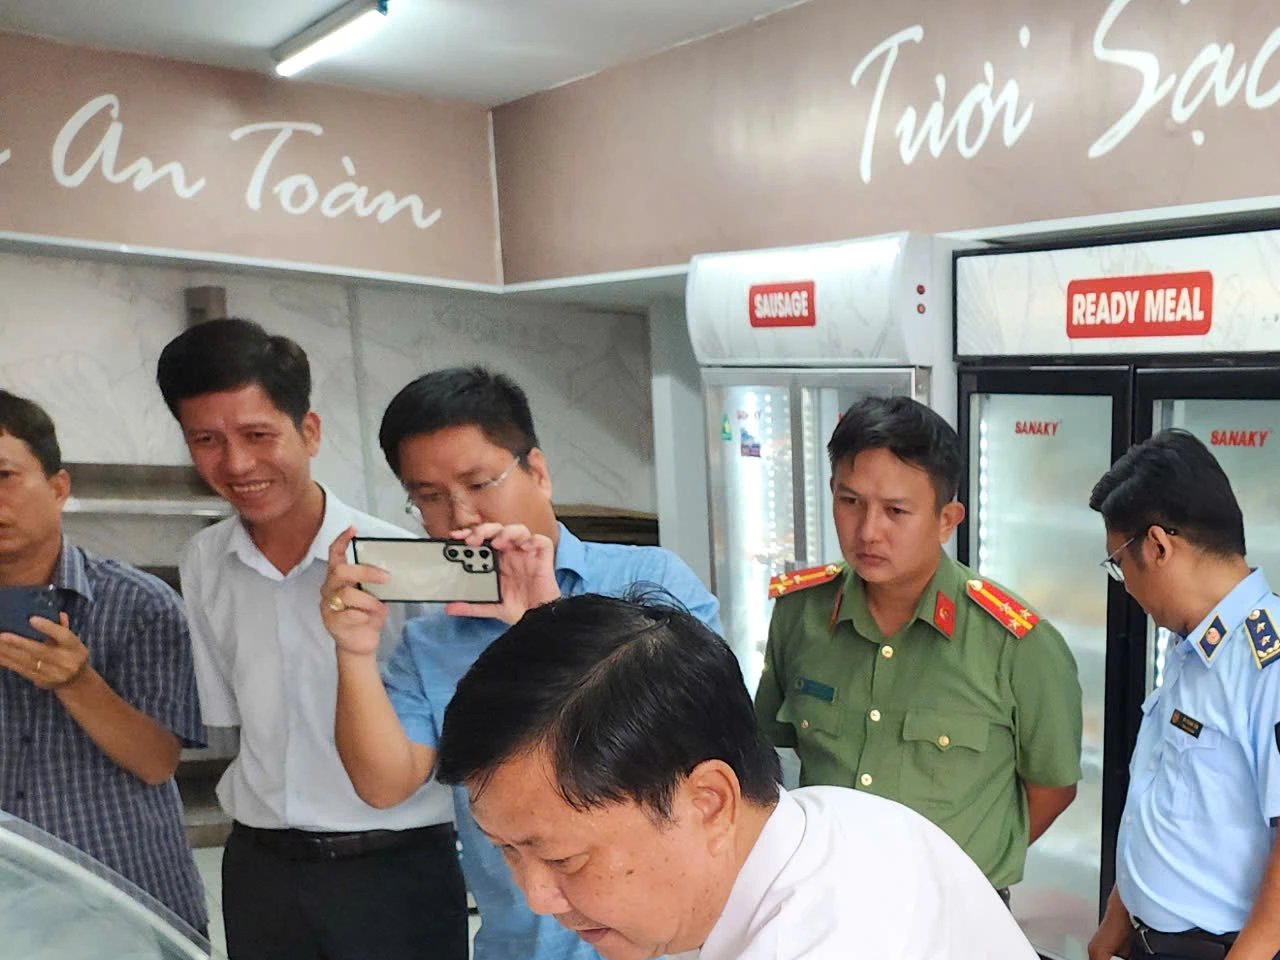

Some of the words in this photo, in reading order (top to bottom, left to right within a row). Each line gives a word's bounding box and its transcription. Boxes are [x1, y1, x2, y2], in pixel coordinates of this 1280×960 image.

[850, 26, 1034, 183] Tươi
[230, 121, 441, 230] Toàn
[754, 290, 809, 319] SAUSAGE
[1072, 291, 1138, 326] READY
[1144, 286, 1205, 323] MEAL
[1015, 421, 1059, 437] SANAKY
[1211, 430, 1268, 447] SANAKY
